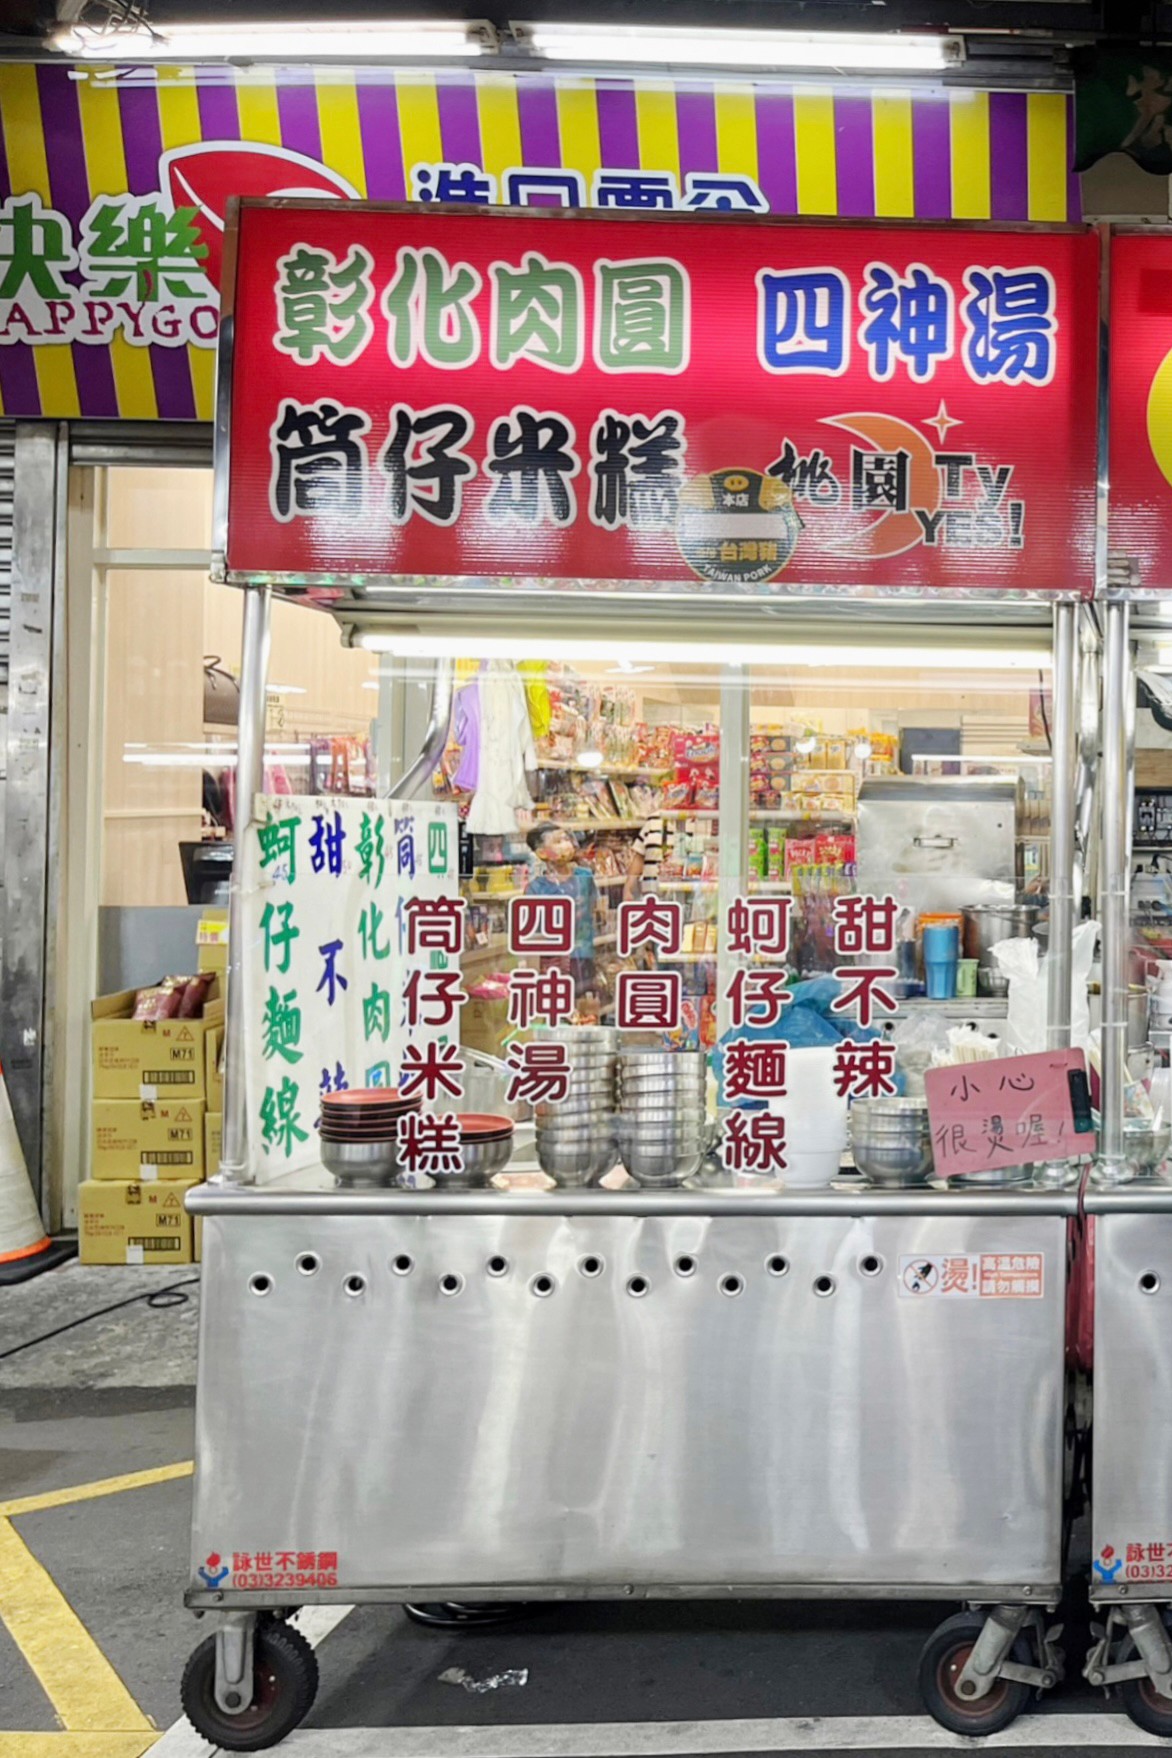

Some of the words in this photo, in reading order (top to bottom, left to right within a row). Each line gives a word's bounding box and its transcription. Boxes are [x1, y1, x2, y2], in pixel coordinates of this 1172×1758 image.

[274, 243, 691, 375] 彰化肉圓
[756, 261, 1058, 387] 四神湯
[270, 398, 686, 529] 筒仔米糕
[766, 437, 911, 514] 桃園
[722, 493, 749, 507] 本店
[911, 499, 1025, 549] YES!
[703, 564, 742, 583] TAIWAN
[743, 565, 773, 582] PORK
[721, 541, 777, 562] 台灣豬
[257, 811, 309, 1158] 蚵仔麵線
[615, 893, 683, 1031] 肉圓
[506, 895, 575, 1103] 四神湯
[831, 894, 900, 1100] 甜不辣
[172, 1048, 193, 1060] M71
[398, 894, 467, 1174] 筒仔米糕
[722, 895, 793, 1174] 蚵仔麵線
[951, 1073, 1035, 1102] 小心
[170, 1129, 191, 1140] M71
[158, 1215, 179, 1226] M71
[941, 1257, 977, 1293] 燙!
